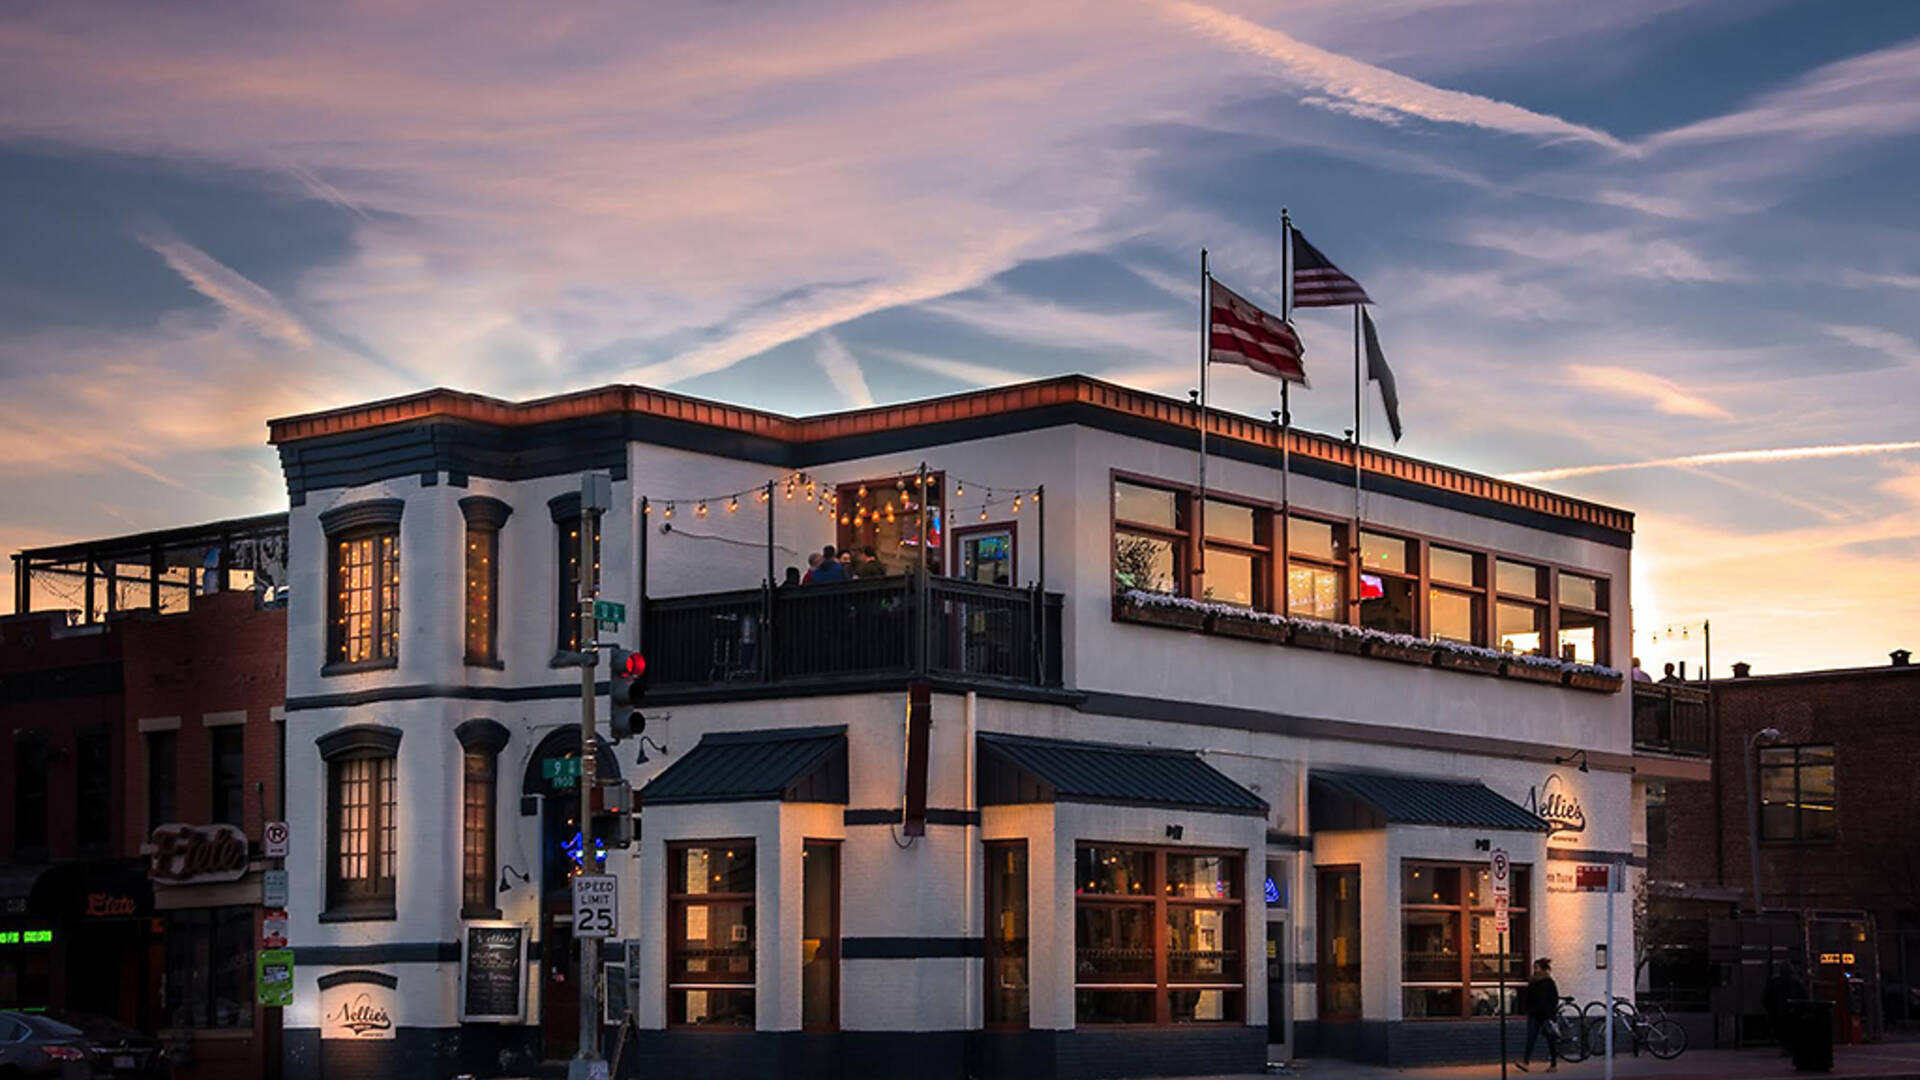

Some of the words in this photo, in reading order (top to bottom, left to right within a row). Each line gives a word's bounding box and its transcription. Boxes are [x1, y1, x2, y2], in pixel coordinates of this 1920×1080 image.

[554, 761, 561, 775] 9
[1523, 773, 1584, 820] Nellie's
[577, 882, 614, 892] SPEED
[581, 895, 609, 905] LIMIT
[578, 908, 613, 931] 25
[326, 992, 391, 1023] Nellie's
